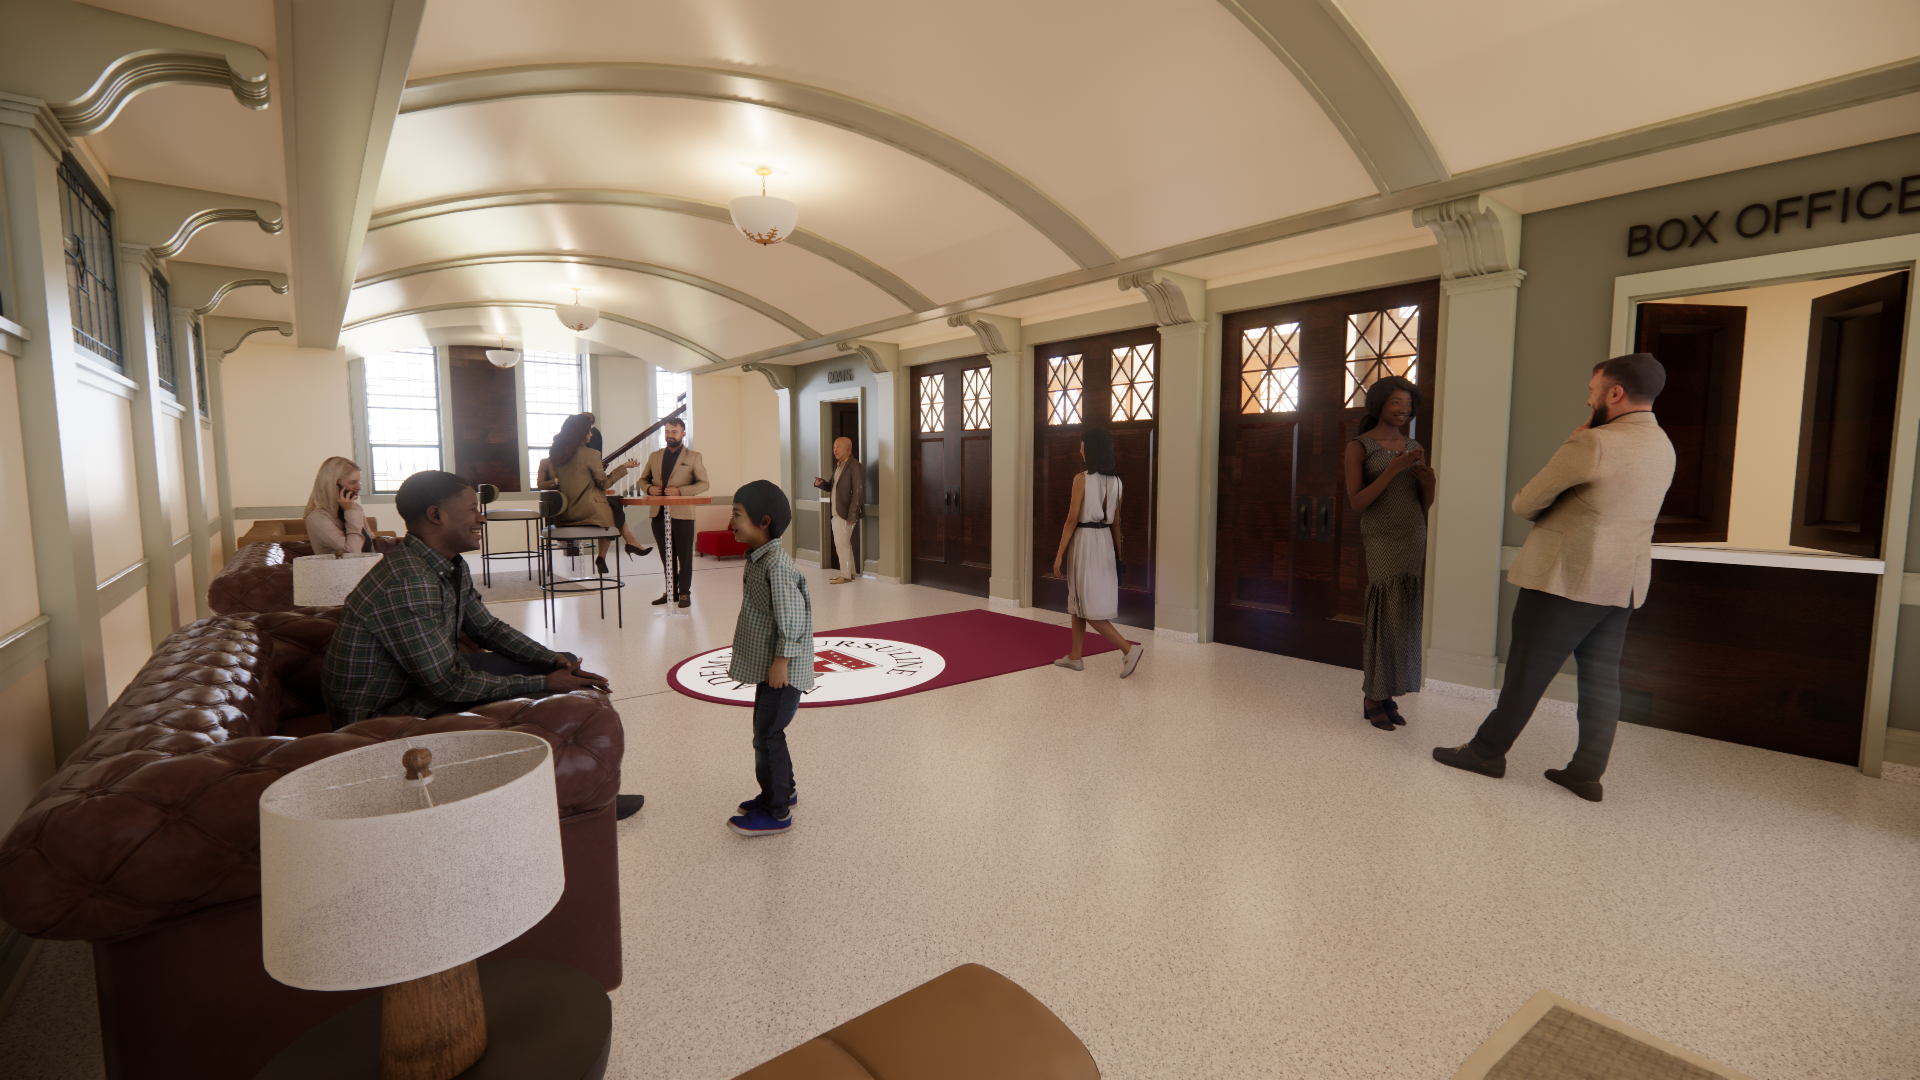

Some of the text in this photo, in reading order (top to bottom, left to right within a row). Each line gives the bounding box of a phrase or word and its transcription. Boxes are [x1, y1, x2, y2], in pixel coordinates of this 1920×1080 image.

[1627, 174, 1920, 257] BOX OFFICE
[827, 367, 853, 384] COATS
